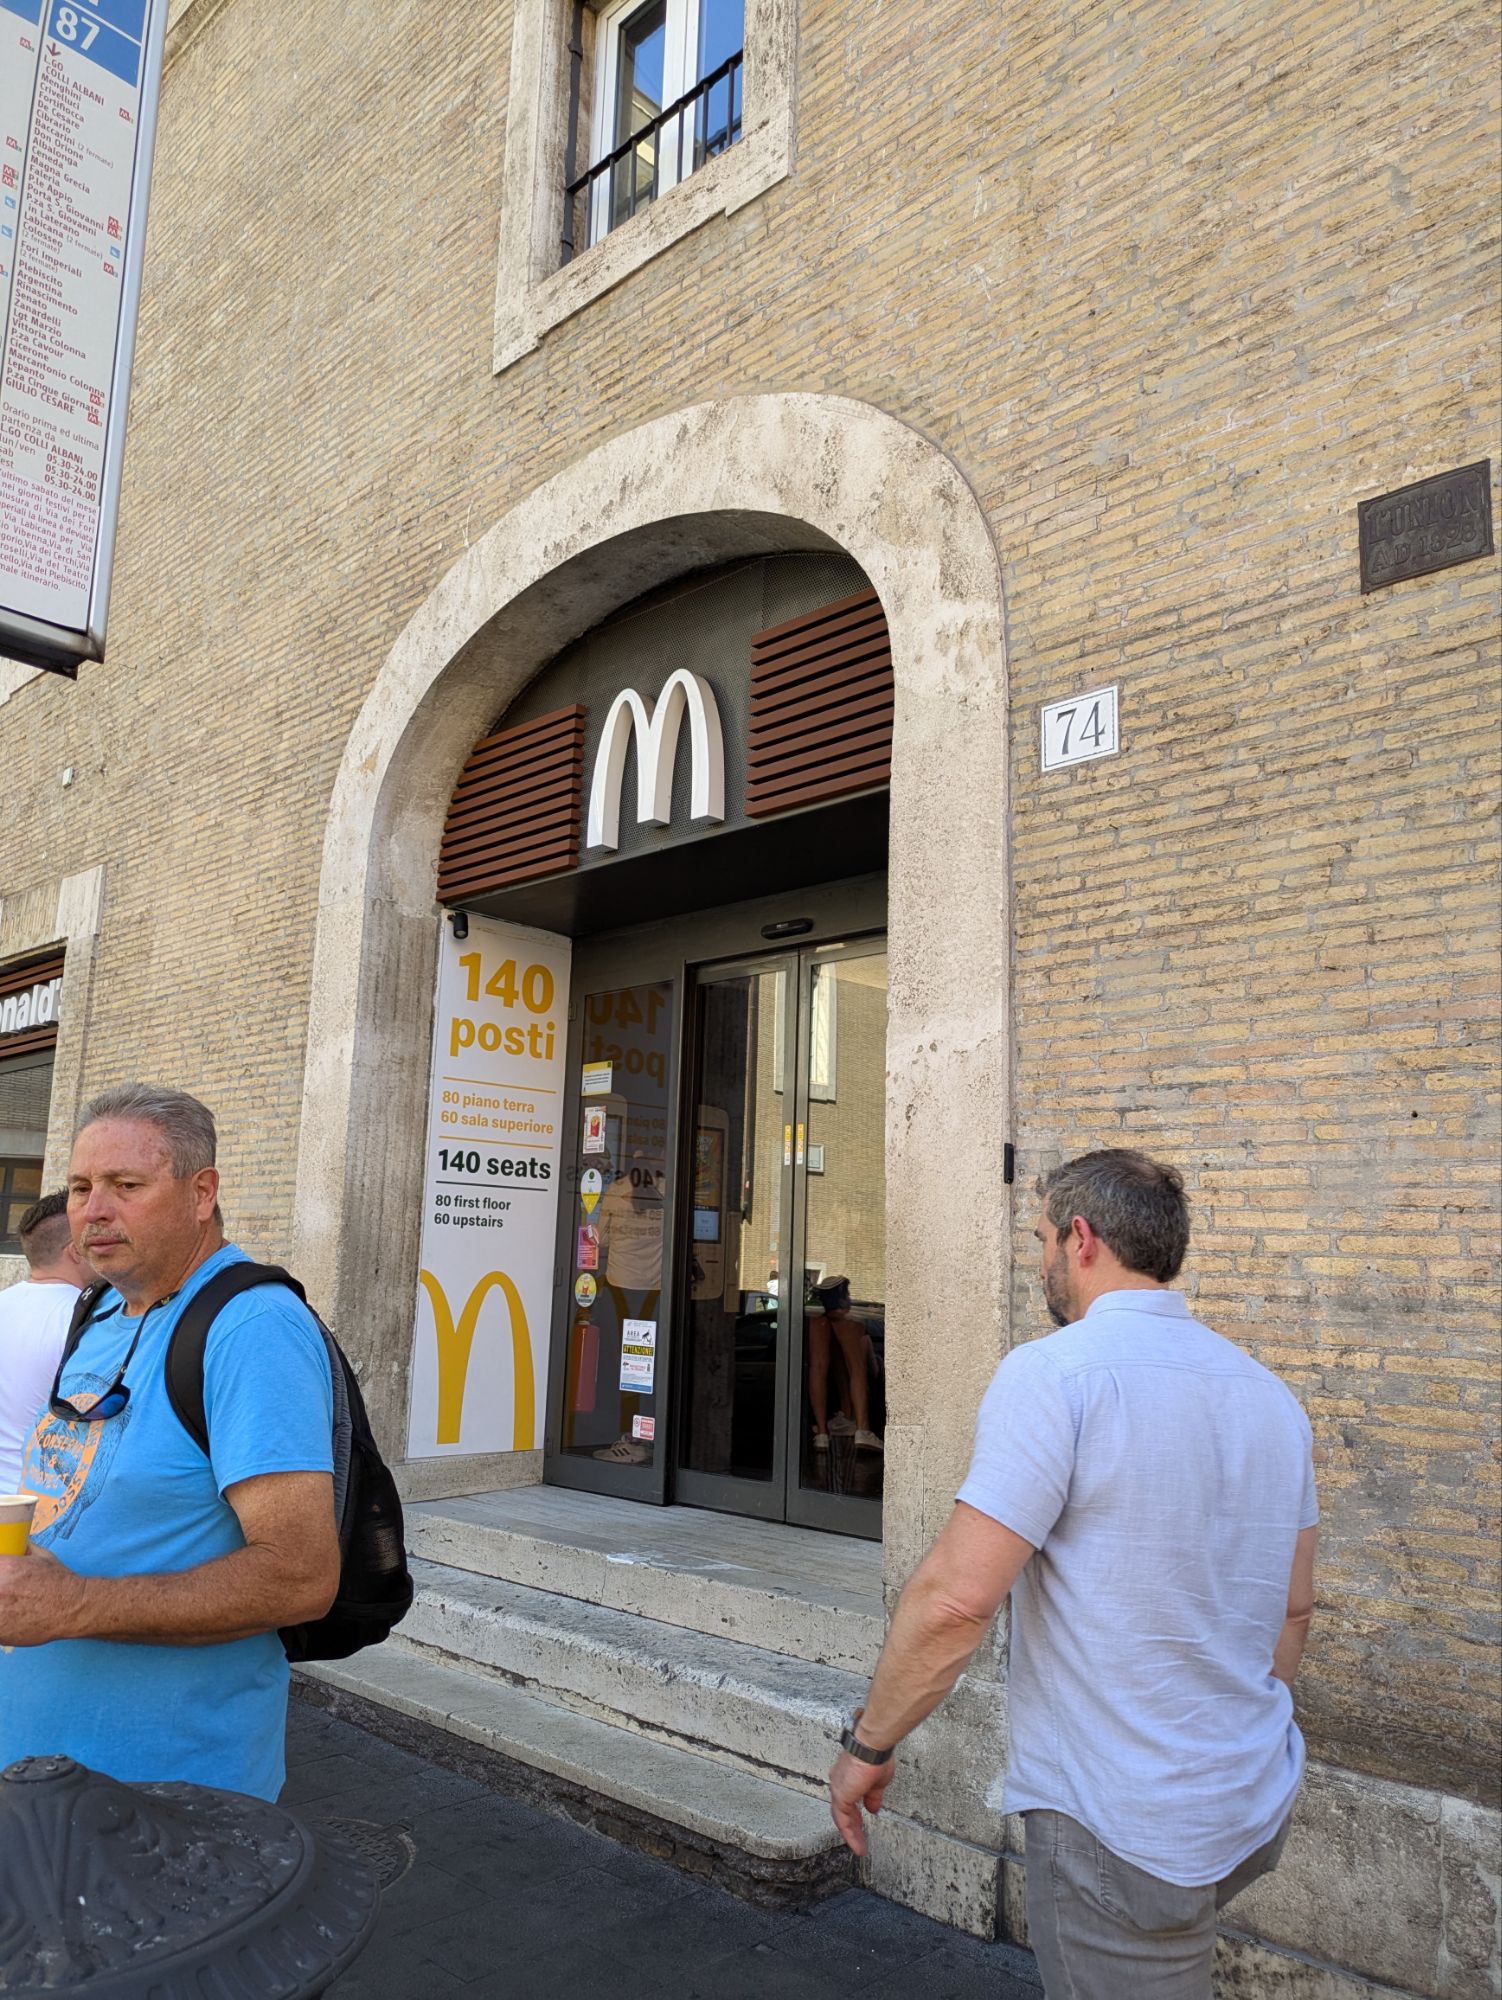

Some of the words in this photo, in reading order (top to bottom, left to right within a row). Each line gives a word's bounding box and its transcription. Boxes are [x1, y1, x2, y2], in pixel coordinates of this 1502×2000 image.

[56, 7, 99, 50] 87
[44, 54, 63, 72] L.GO
[40, 82, 80, 110] Crivelluci
[42, 73, 81, 102] Menghini
[46, 66, 69, 84] COLLI
[72, 81, 104, 106] ALBANI
[37, 109, 71, 134] Cibrario
[38, 100, 48, 111] De
[52, 108, 80, 129] Cesare
[39, 91, 84, 122] Fortifiocca
[34, 127, 51, 142] Don
[55, 139, 83, 160] Orione
[35, 119, 75, 145] Baccarini
[32, 146, 63, 169] Ceneda
[33, 137, 78, 167] Albalonga
[29, 174, 44, 188] P.le
[47, 185, 72, 203] Appio
[30, 165, 60, 187] Faleria
[31, 155, 60, 177] Magna
[64, 174, 90, 194] Grecia
[27, 193, 43, 208] P.za
[48, 204, 54, 214] S.
[59, 210, 97, 236] Giovanni
[28, 183, 51, 202] Porta
[55, 198, 62, 208] S.
[66, 204, 104, 231] Giovanni
[29, 204, 37, 214] in
[41, 210, 79, 237] Laterano
[23, 222, 62, 248] Colosseo
[24, 212, 63, 238] Labicana
[19, 259, 62, 288] Plebiscito
[21, 240, 39, 255] Fori
[42, 251, 82, 278] Imperiali
[16, 288, 47, 310] Senato
[17, 270, 62, 298] Argentina
[17, 279, 78, 315] Rinascimento
[13, 308, 28, 321] Lgt
[31, 316, 62, 337] Marzio
[15, 299, 61, 327] Zanardelli
[10, 337, 49, 362] Cicerone
[11, 328, 29, 342] P.za
[33, 338, 64, 358] Cavour
[12, 318, 46, 340] Vittoria
[50, 336, 86, 359] Colonna
[8, 357, 44, 380] Lepanto
[9, 347, 67, 380] Marcantonio
[70, 375, 105, 398] Colonna
[6, 377, 37, 397] GIULIO
[41, 393, 75, 414] CESARE
[7, 367, 25, 381] P.za
[28, 377, 58, 396] Cinque
[62, 392, 99, 414] Giornate
[1, 414, 41, 435] partenza
[45, 431, 55, 442] da
[3, 402, 30, 420] Orario
[32, 416, 57, 432] prima
[60, 428, 70, 437] ed
[73, 433, 99, 451] ultima
[1, 423, 20, 438] L.GO
[24, 433, 48, 449] COLLI
[51, 445, 83, 464] ALBANI
[0, 445, 14, 457] ab
[46, 464, 96, 491] 05.30-24.00
[0, 456, 14, 468] est
[45, 474, 95, 501] 05.30-24.00
[47, 453, 97, 481] 05.30-24.00
[0, 490, 29, 506] iusura
[34, 503, 41, 512] di
[46, 508, 58, 519] Via
[79, 521, 94, 533] Fori
[2, 481, 15, 492] nei
[18, 488, 42, 500] giorni
[46, 498, 70, 514] festivi
[73, 510, 85, 520] per
[88, 515, 95, 524] la
[31, 483, 58, 498] sabato
[77, 502, 96, 514] mese
[0, 501, 26, 516] periali
[28, 510, 35, 520] la
[38, 514, 57, 529] linea
[66, 527, 93, 543] deviata
[4, 511, 16, 523] Via
[21, 518, 56, 538] Labicana
[60, 535, 73, 545] per
[80, 542, 92, 553] Via
[0, 541, 42, 563] roselli,Via
[64, 565, 88, 581] Teatro
[1, 532, 36, 551] gorio,Via
[54, 552, 90, 572] Cerchi,Via
[65, 547, 73, 555] di
[77, 550, 91, 562] San
[0, 553, 32, 570] cello,Via
[49, 570, 88, 592] Plebiscito,
[21, 570, 61, 591] itinerario.
[1056, 701, 1106, 755] 74
[460, 952, 554, 1014] 140
[0, 978, 64, 1033] nald'
[450, 1017, 555, 1060] posti
[442, 1090, 459, 1104] 80
[463, 1093, 500, 1109] piano
[503, 1098, 534, 1113] terra
[441, 1110, 458, 1124] 60
[461, 1114, 488, 1127] sala
[492, 1119, 553, 1134] superiore
[438, 1149, 480, 1173] 140
[487, 1157, 551, 1179] seats
[435, 1195, 451, 1206] 80
[454, 1195, 480, 1209] first
[482, 1197, 511, 1210] floor
[434, 1213, 449, 1224] 60
[453, 1215, 503, 1229] upstairs
